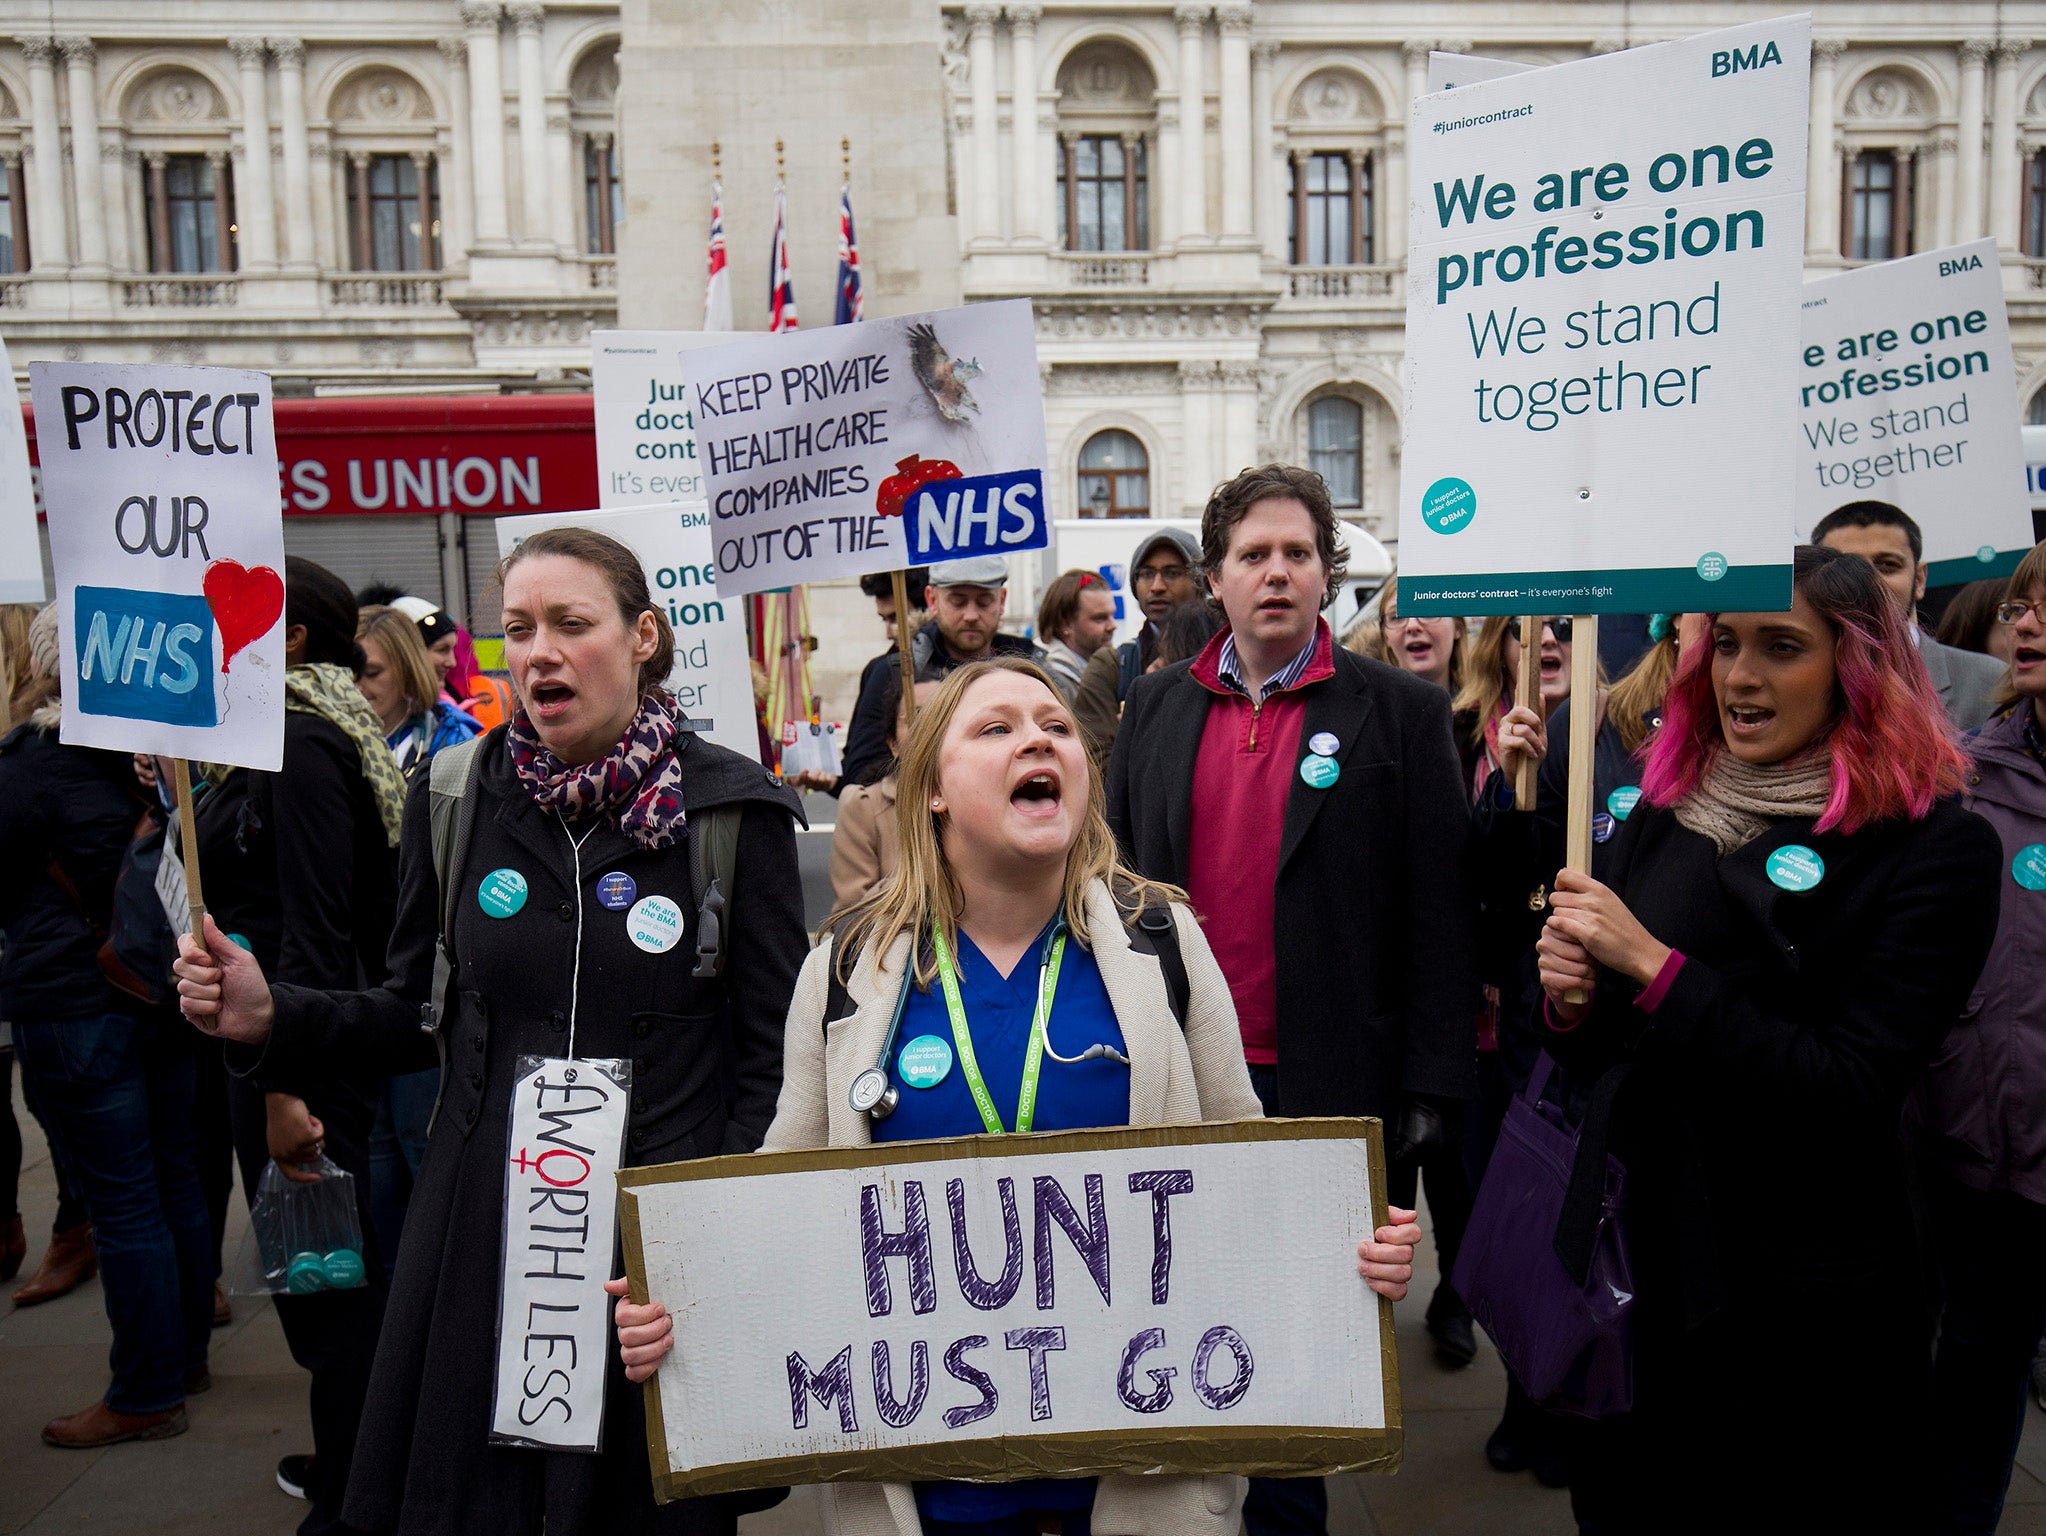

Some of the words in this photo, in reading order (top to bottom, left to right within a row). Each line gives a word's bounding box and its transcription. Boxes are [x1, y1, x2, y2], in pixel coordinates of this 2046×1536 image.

[1711, 40, 1782, 78] BMA
[1433, 104, 1533, 135] #juniorcontract
[1433, 173, 1516, 228] We
[1532, 161, 1629, 212] are
[1648, 136, 1774, 194] one
[1436, 207, 1764, 305] profession
[1939, 255, 1983, 277] BMA
[1467, 307, 1547, 359] We
[1565, 281, 1720, 350] stand
[1837, 329, 1898, 361] are
[1910, 309, 1987, 345] one
[697, 372, 771, 419] KEEP
[781, 354, 889, 404] PRIVATE
[1475, 360, 1711, 432] together
[61, 386, 259, 455] PROTECT
[1803, 417, 1858, 450] We
[1870, 393, 1969, 439] stand
[348, 456, 541, 508] UNION
[612, 471, 642, 494] It's
[1816, 440, 1968, 489] together
[715, 465, 869, 519] COMPANIES
[1434, 487, 1459, 504] support
[1445, 490, 1470, 507] doctors
[116, 496, 210, 561] OUR
[681, 513, 712, 528] BM
[917, 482, 1036, 553] NHS
[1447, 508, 1467, 522] BMA
[829, 516, 889, 553] THE
[1414, 591, 1441, 601] Junior
[1442, 589, 1479, 599] doctors'
[1480, 589, 1519, 598] contract
[1528, 587, 1541, 597] it's
[1542, 586, 1590, 599] everyone's
[1591, 586, 1613, 598] fight
[82, 611, 203, 694] NHS
[497, 890, 511, 904] BMA
[648, 900, 661, 911] We
[662, 909, 676, 918] are
[641, 907, 656, 919] the
[657, 914, 676, 928] BMA
[645, 934, 663, 948] BMA
[943, 969, 958, 1002] DOCTOR
[1044, 961, 1056, 992] DOCTOR
[952, 1007, 966, 1041] DOCTOR
[919, 1065, 937, 1074] BMA
[961, 1046, 977, 1081] DOCTOR
[1027, 1037, 1040, 1073] DOCTOR
[974, 1086, 996, 1123] DOCTOR
[1021, 1080, 1033, 1118] DOCTOR
[860, 1169, 1194, 1318] HUNT
[787, 1325, 1066, 1433] MUST
[1117, 1324, 1256, 1414] GO
